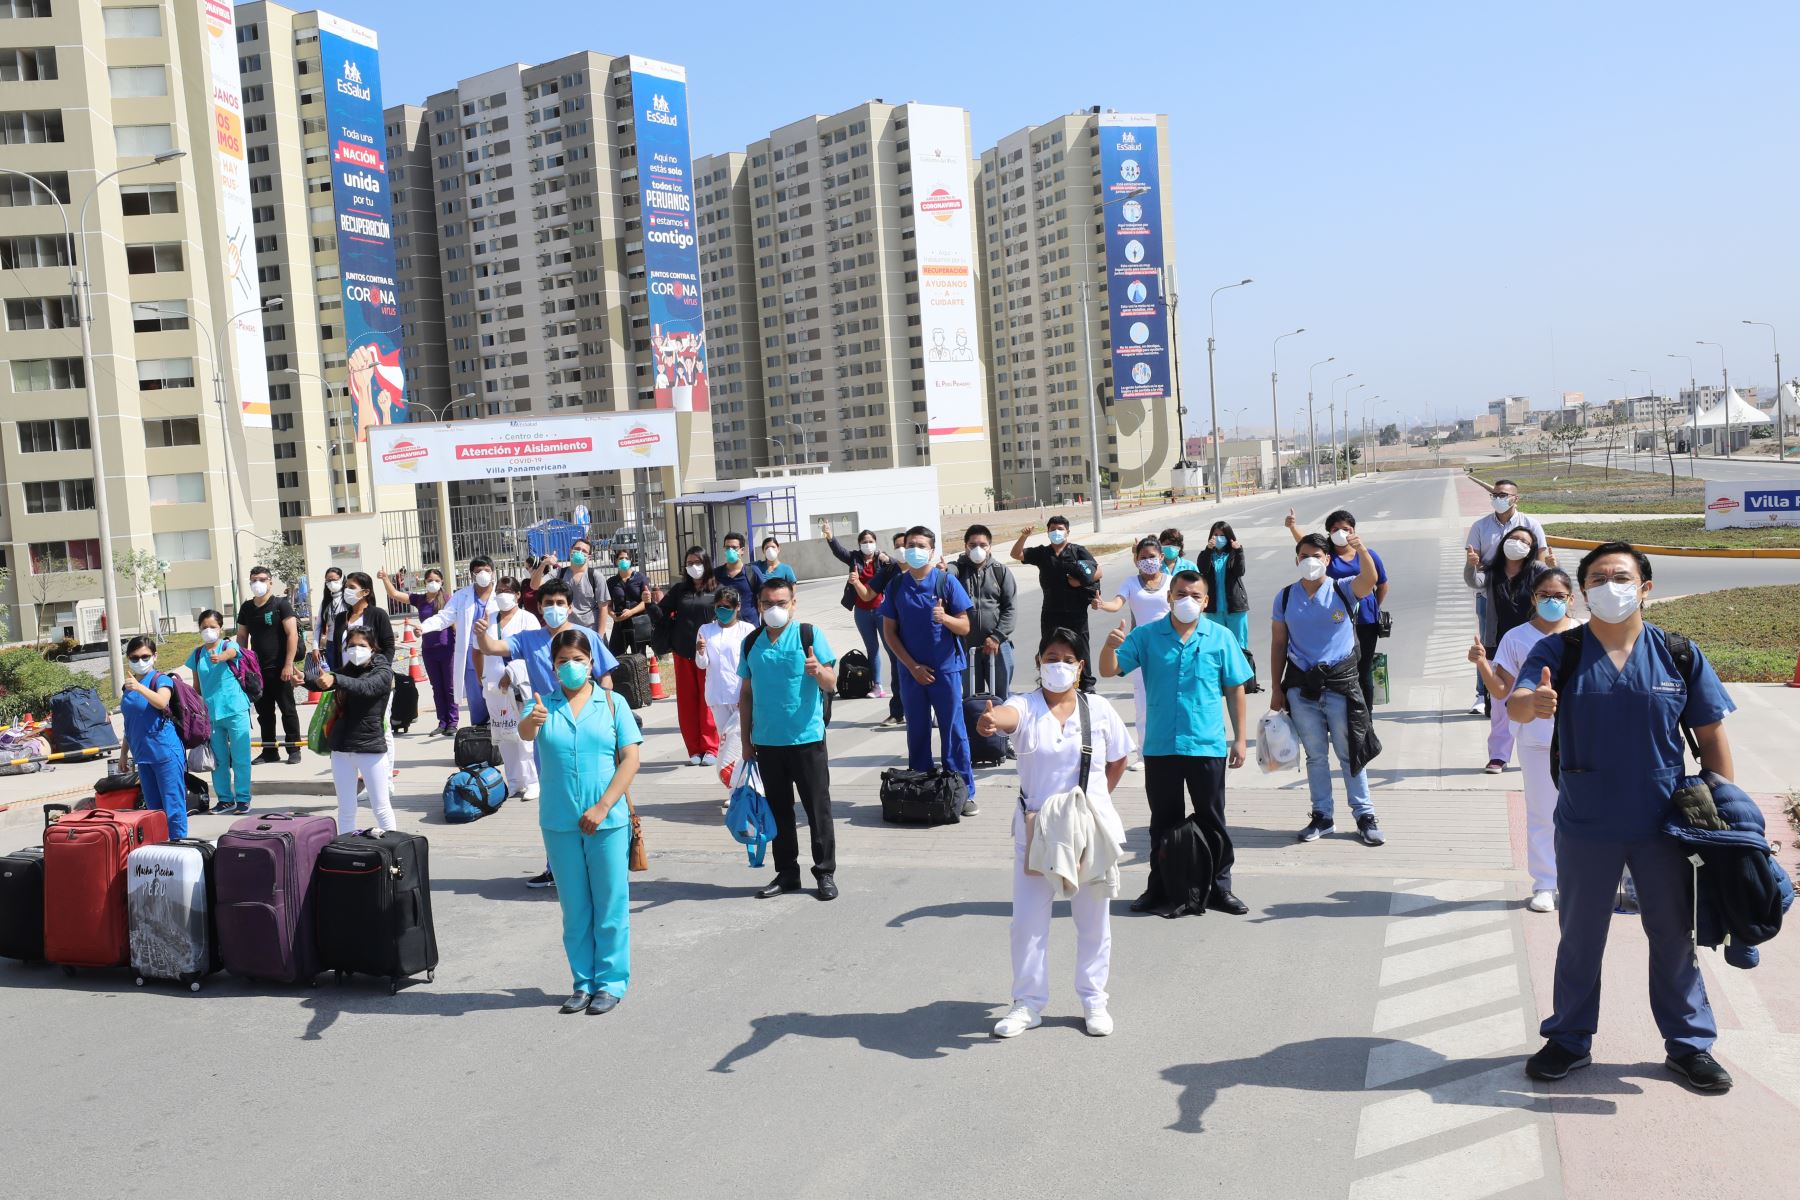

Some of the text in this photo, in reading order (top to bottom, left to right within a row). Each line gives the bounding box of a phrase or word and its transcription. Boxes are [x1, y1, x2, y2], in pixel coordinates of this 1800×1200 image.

[337, 78, 371, 101] EsSalud
[646, 110, 677, 126] EsSalud
[342, 127, 374, 144] Toda una
[1116, 143, 1142, 151] EsSalud
[342, 147, 377, 165] NACIÓN
[668, 167, 682, 175] solo
[343, 171, 380, 193] unida
[652, 181, 682, 192] todos los
[353, 195, 374, 207] por tu
[646, 189, 690, 211] PERUANOS
[340, 214, 391, 239] RECUPERACIÓN
[656, 217, 683, 227] estamos
[648, 229, 693, 249] contigo
[345, 272, 395, 286] JUNTOS CONTRA EL
[651, 271, 669, 279] JUNTOS
[669, 272, 690, 280] CONTRA
[505, 431, 544, 441] Centro de
[384, 450, 427, 461] CORONAVIRUS
[461, 441, 588, 458] Atención y Aislamiento
[486, 463, 567, 474] Villa Panamericana
[1750, 495, 1790, 508] Villa
